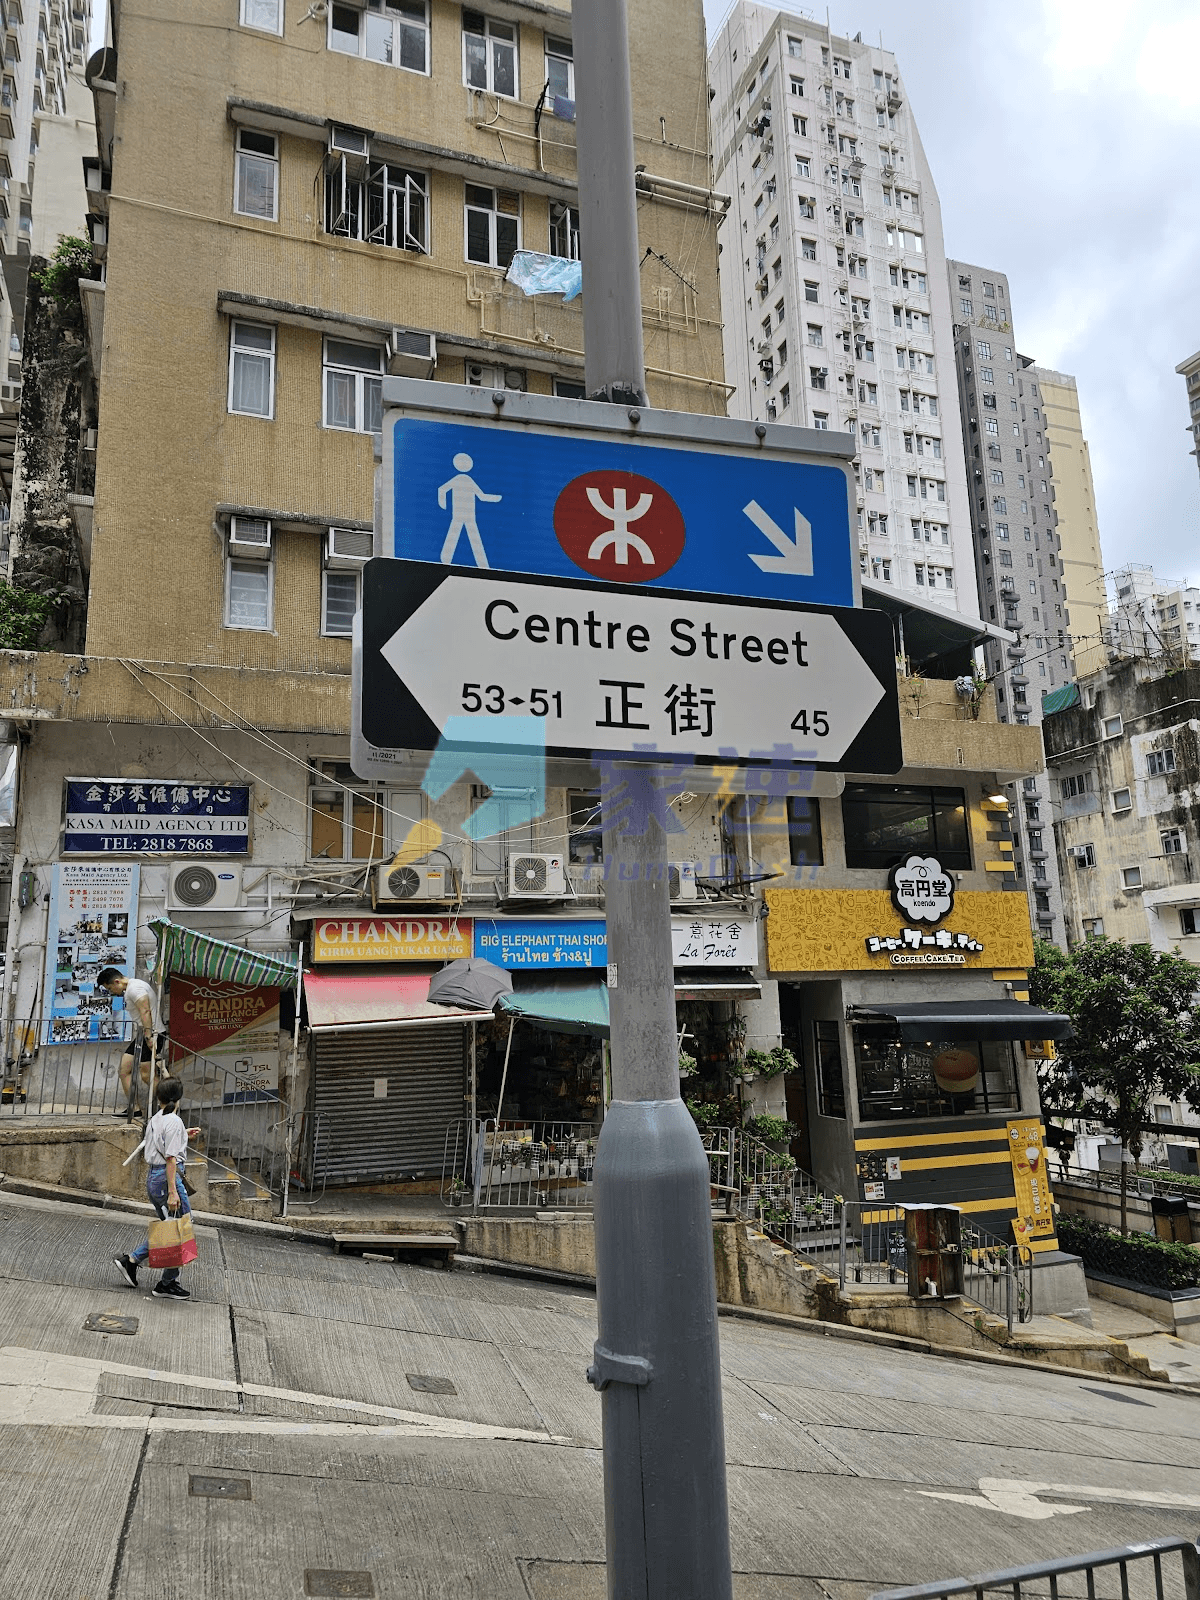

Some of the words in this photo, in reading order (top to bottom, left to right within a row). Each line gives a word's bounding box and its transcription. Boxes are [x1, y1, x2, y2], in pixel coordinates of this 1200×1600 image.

[485, 599, 650, 653] Centre
[670, 618, 808, 667] Street
[595, 679, 716, 737] 正街
[790, 709, 830, 737] 45
[85, 784, 231, 804] 金莎來僱傭中心
[102, 803, 214, 814] 有限公司
[66, 818, 104, 830] KASA
[110, 819, 150, 831] MAID
[155, 820, 216, 831] AGENCY
[220, 820, 247, 832] LTD
[100, 837, 137, 850] TEL:
[140, 838, 176, 851] 2818
[178, 838, 214, 850] 7868
[899, 880, 949, 898] 高円堂
[318, 921, 464, 944] CHANDRA
[480, 935, 500, 947] BIG
[501, 935, 556, 946] ELEPHANT
[558, 935, 581, 946] THAI
[319, 947, 357, 957] KIRIM
[357, 946, 389, 957] UANG
[391, 945, 431, 956] TUKAR
[433, 944, 464, 954] UANG
[501, 947, 549, 963] ร้านไทย
[679, 943, 700, 958] La
[703, 943, 737, 961] Forêt
[183, 997, 266, 1013] CHANDRA
[193, 1008, 259, 1020] REMITTANCE
[253, 1064, 272, 1072] TSL
[236, 1079, 271, 1088] CHNDRA
